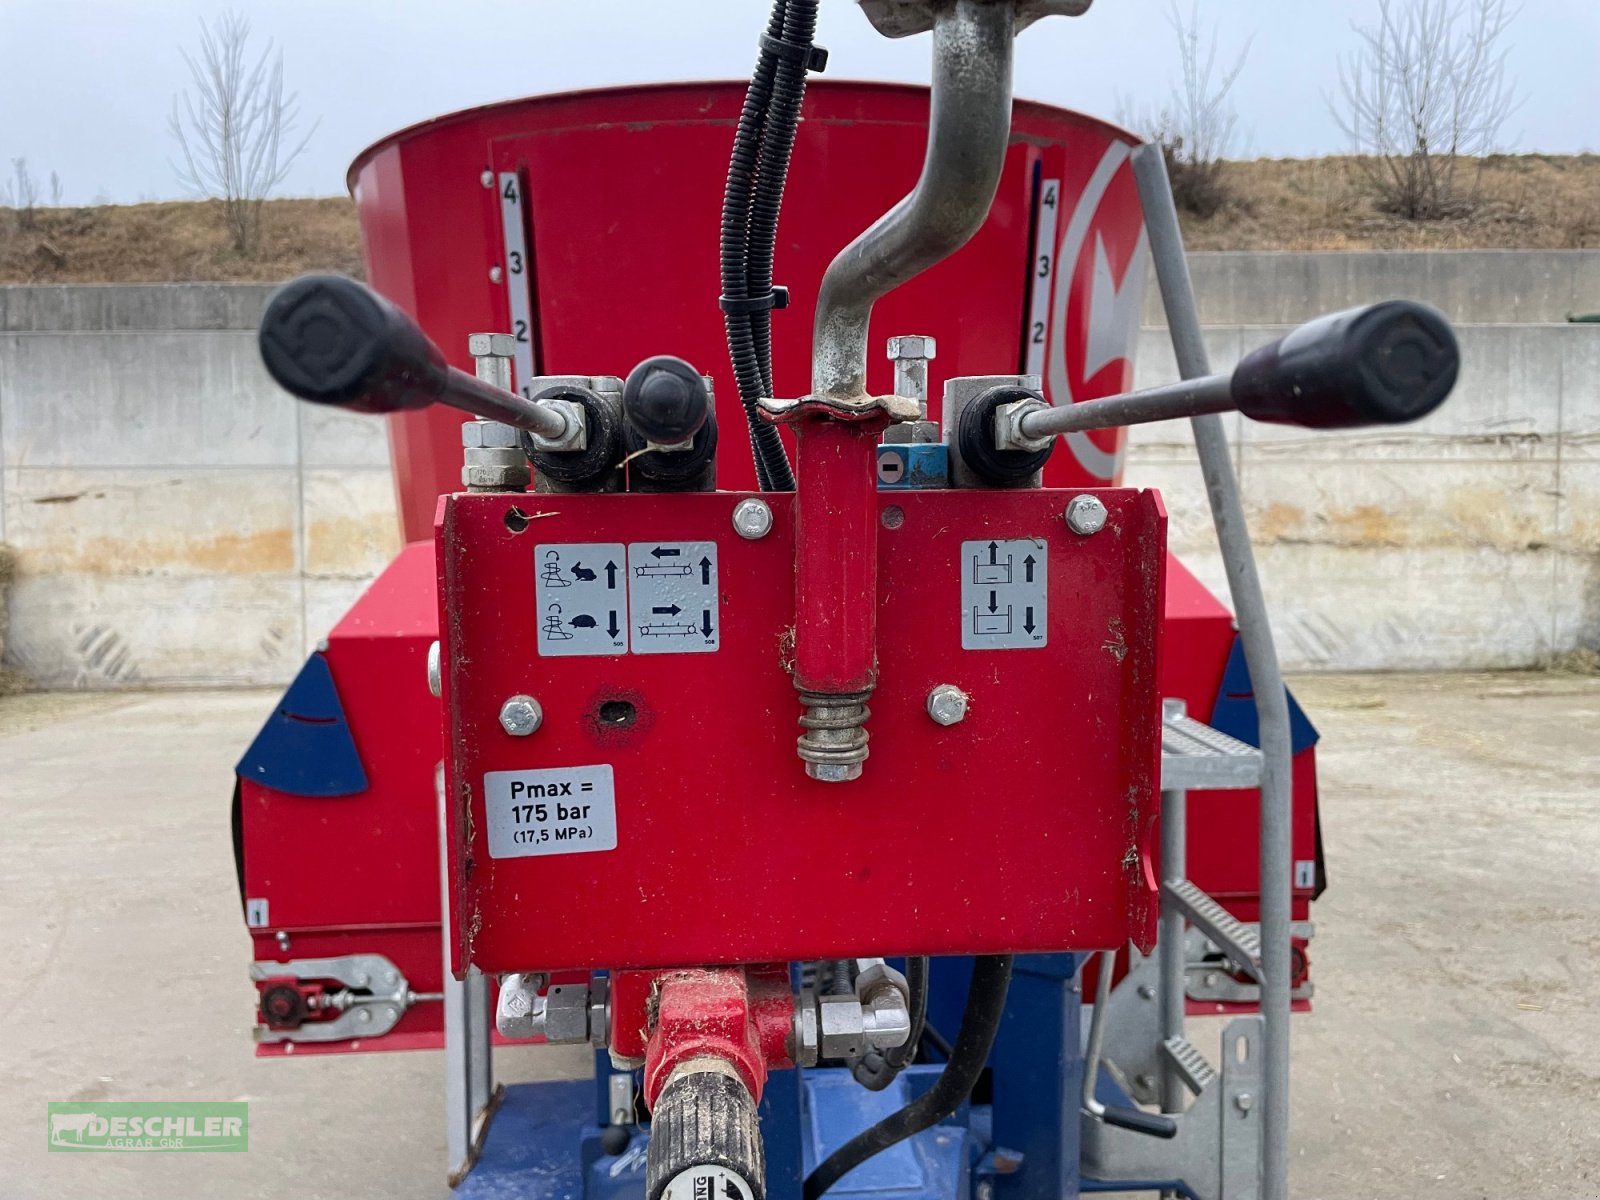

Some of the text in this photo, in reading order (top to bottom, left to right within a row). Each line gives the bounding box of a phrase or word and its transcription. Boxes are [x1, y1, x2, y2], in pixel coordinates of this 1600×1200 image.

[504, 180, 516, 204] 4
[1043, 186, 1056, 209] 4
[509, 251, 522, 274] 3
[1038, 255, 1050, 277] 3
[515, 320, 528, 342] 2
[1033, 322, 1044, 343] 2
[511, 781, 572, 799] Pmax
[512, 803, 590, 823] 175 bar
[513, 825, 593, 844] (17,5 MPa)
